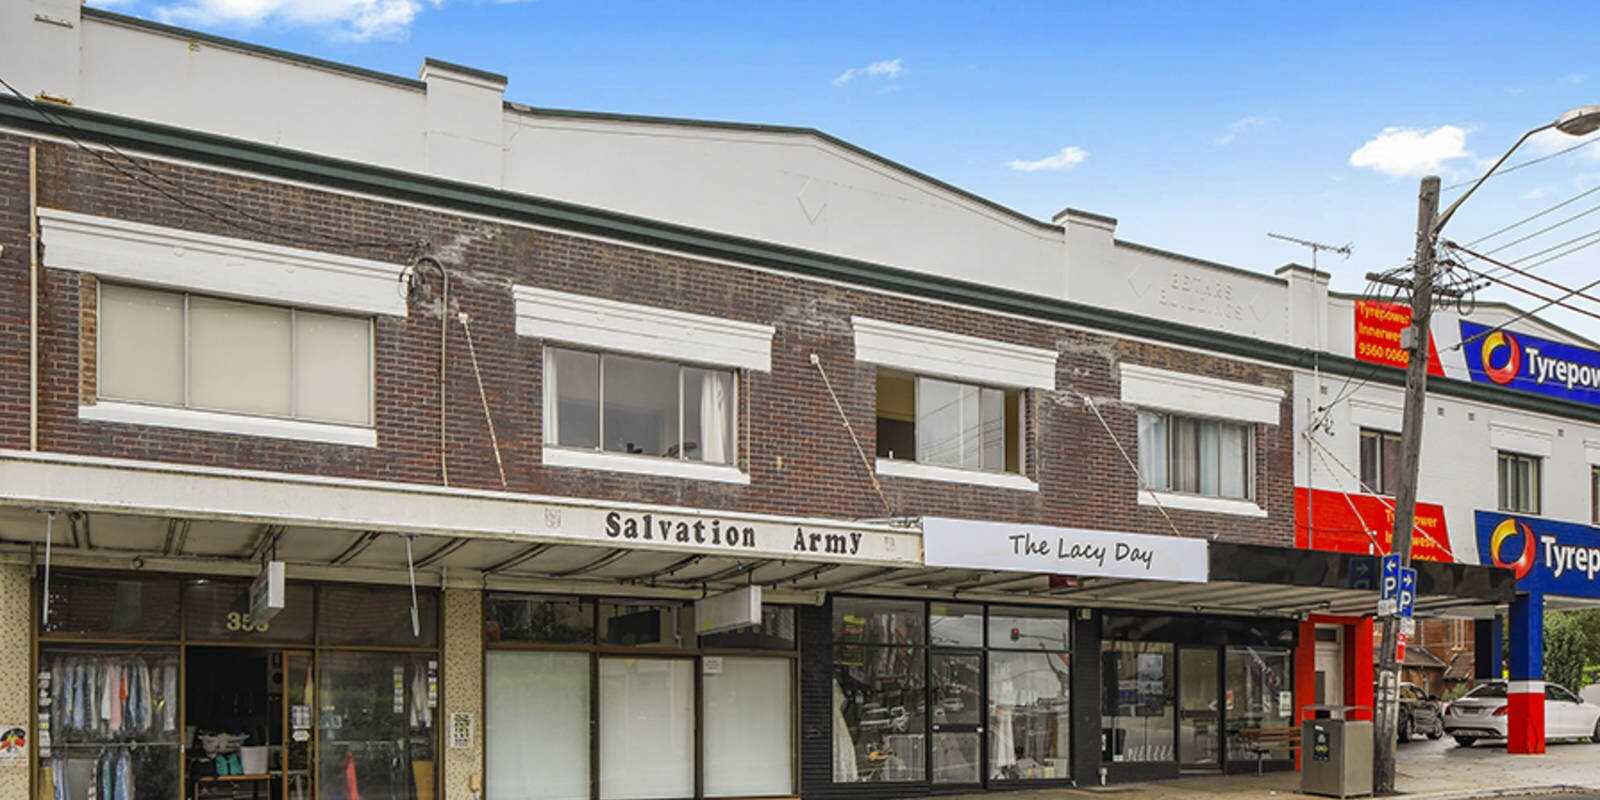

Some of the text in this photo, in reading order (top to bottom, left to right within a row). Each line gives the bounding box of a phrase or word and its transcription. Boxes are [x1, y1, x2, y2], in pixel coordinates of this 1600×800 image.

[1358, 301, 1410, 324] Tyrepower
[1359, 322, 1402, 341] Innerwes
[1385, 509, 1438, 528] Tyower
[605, 511, 862, 555] Salvation Army
[1009, 533, 1153, 570] The Lacy Day
[1541, 535, 1600, 580] Tyrep
[1384, 577, 1397, 599] P
[1400, 591, 1412, 612] P
